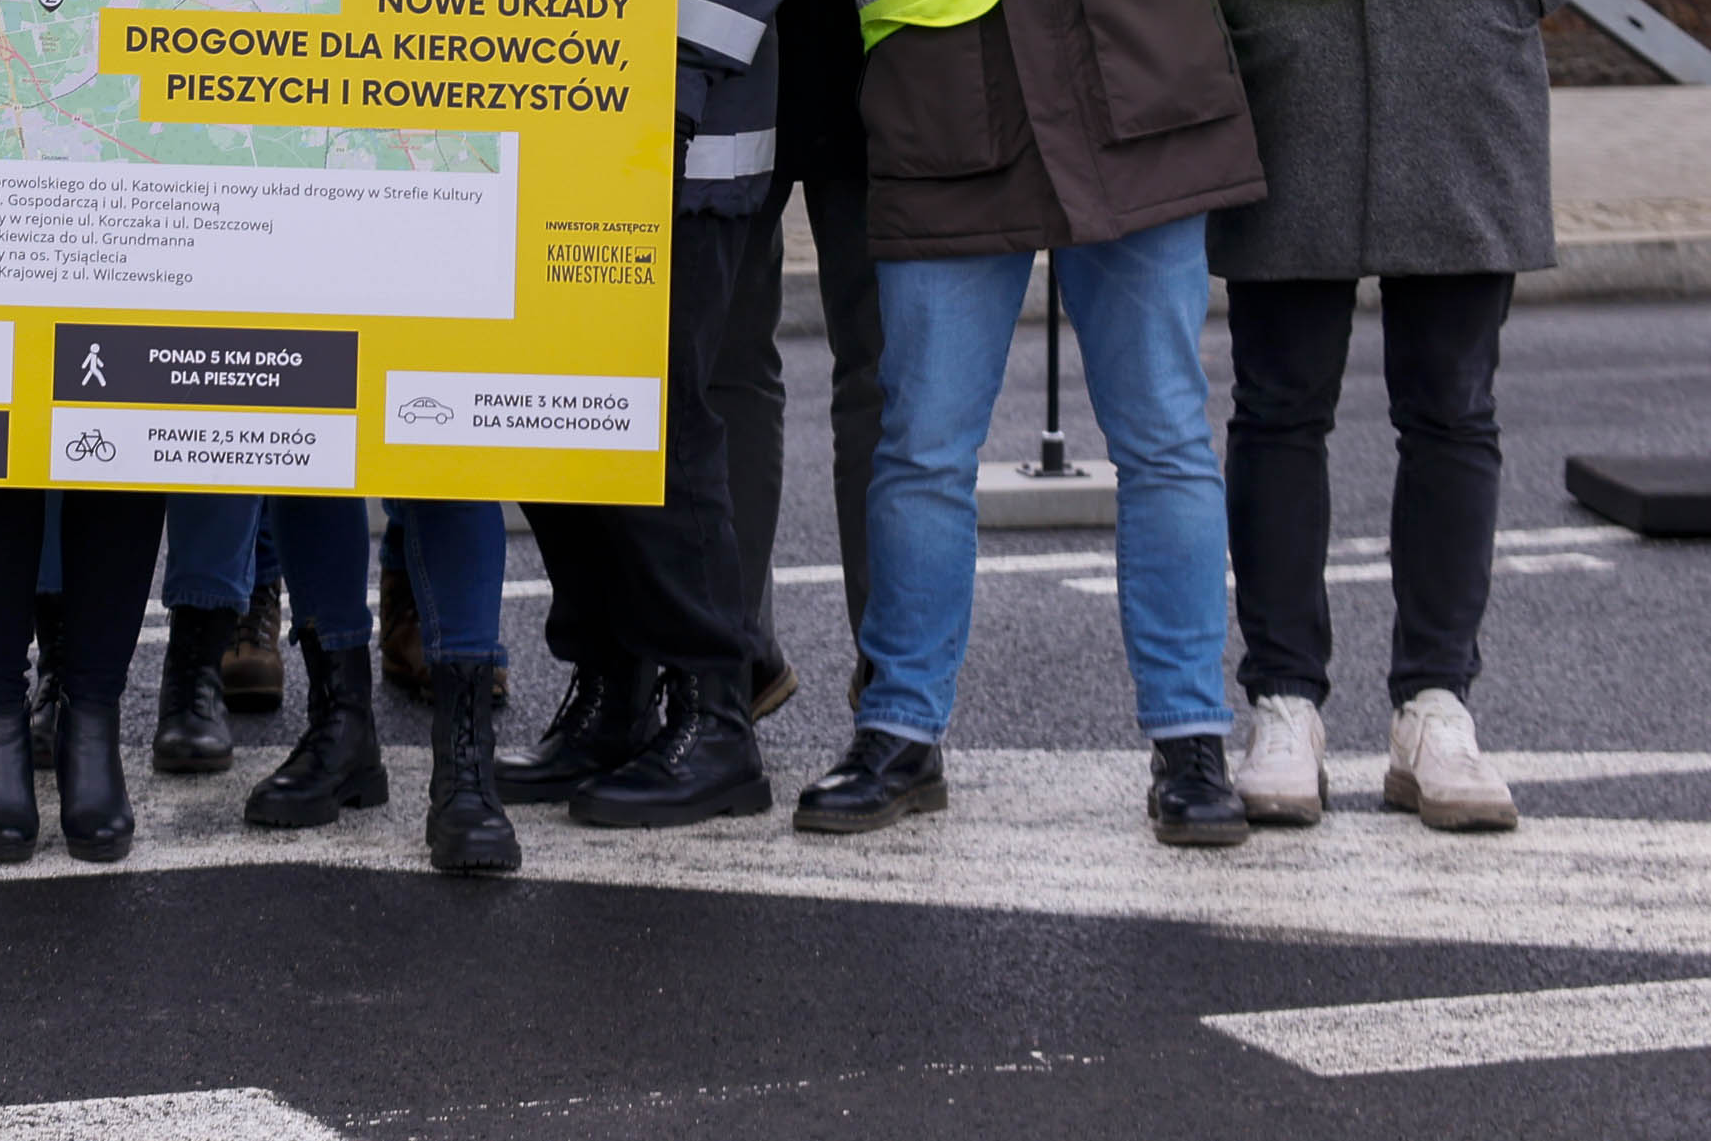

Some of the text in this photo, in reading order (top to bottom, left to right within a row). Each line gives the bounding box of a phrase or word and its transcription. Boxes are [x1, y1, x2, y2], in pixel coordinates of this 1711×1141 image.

[126, 25, 629, 72] DROGOWE DLA KIEROWCÓW,
[167, 73, 630, 113] PIESZYCH I ROWERZYSTÓW
[88, 177, 107, 191] do
[110, 178, 128, 192] ul.
[132, 179, 209, 197] Katowickiej
[221, 184, 259, 199] nowy
[262, 182, 300, 197] układ
[304, 183, 365, 202] drogowy
[368, 189, 380, 199] w
[384, 186, 429, 200] Strefie
[433, 187, 483, 205] Kultury
[7, 193, 99, 212] Gospodarczą
[110, 196, 127, 209] ul.
[131, 197, 220, 215] Porcelanową
[9, 214, 22, 225] w
[25, 214, 74, 229] rejonie
[77, 213, 94, 227] ul.
[98, 214, 161, 229] Korczaka
[172, 216, 189, 229] ul.
[193, 217, 273, 235] Deszczowej
[545, 221, 660, 235] INWESTOR ZASTĘPCZY
[59, 230, 78, 244] do
[81, 231, 98, 245] ul.
[102, 232, 195, 247] Grundmanna
[9, 251, 26, 261] na
[29, 251, 50, 261] os.
[54, 249, 127, 266] Tysiąclecia
[547, 243, 633, 264] KATOWICKIE
[61, 269, 69, 280] z
[72, 267, 89, 280] ul.
[93, 267, 193, 286] Wilczewskiego
[546, 264, 632, 285] INWESTYCJE
[149, 348, 303, 367] PONAD 5 KM DRÓG
[170, 370, 280, 387] DLA PIESZYCH
[474, 393, 629, 411] PRAWIE 3 KM DRÓG
[472, 414, 631, 432] DLA SAMOCHODÓW
[148, 428, 317, 445] PRAWIE 2,5 KM DRÓG
[153, 449, 311, 466] DLA ROWERZYSTÓW
